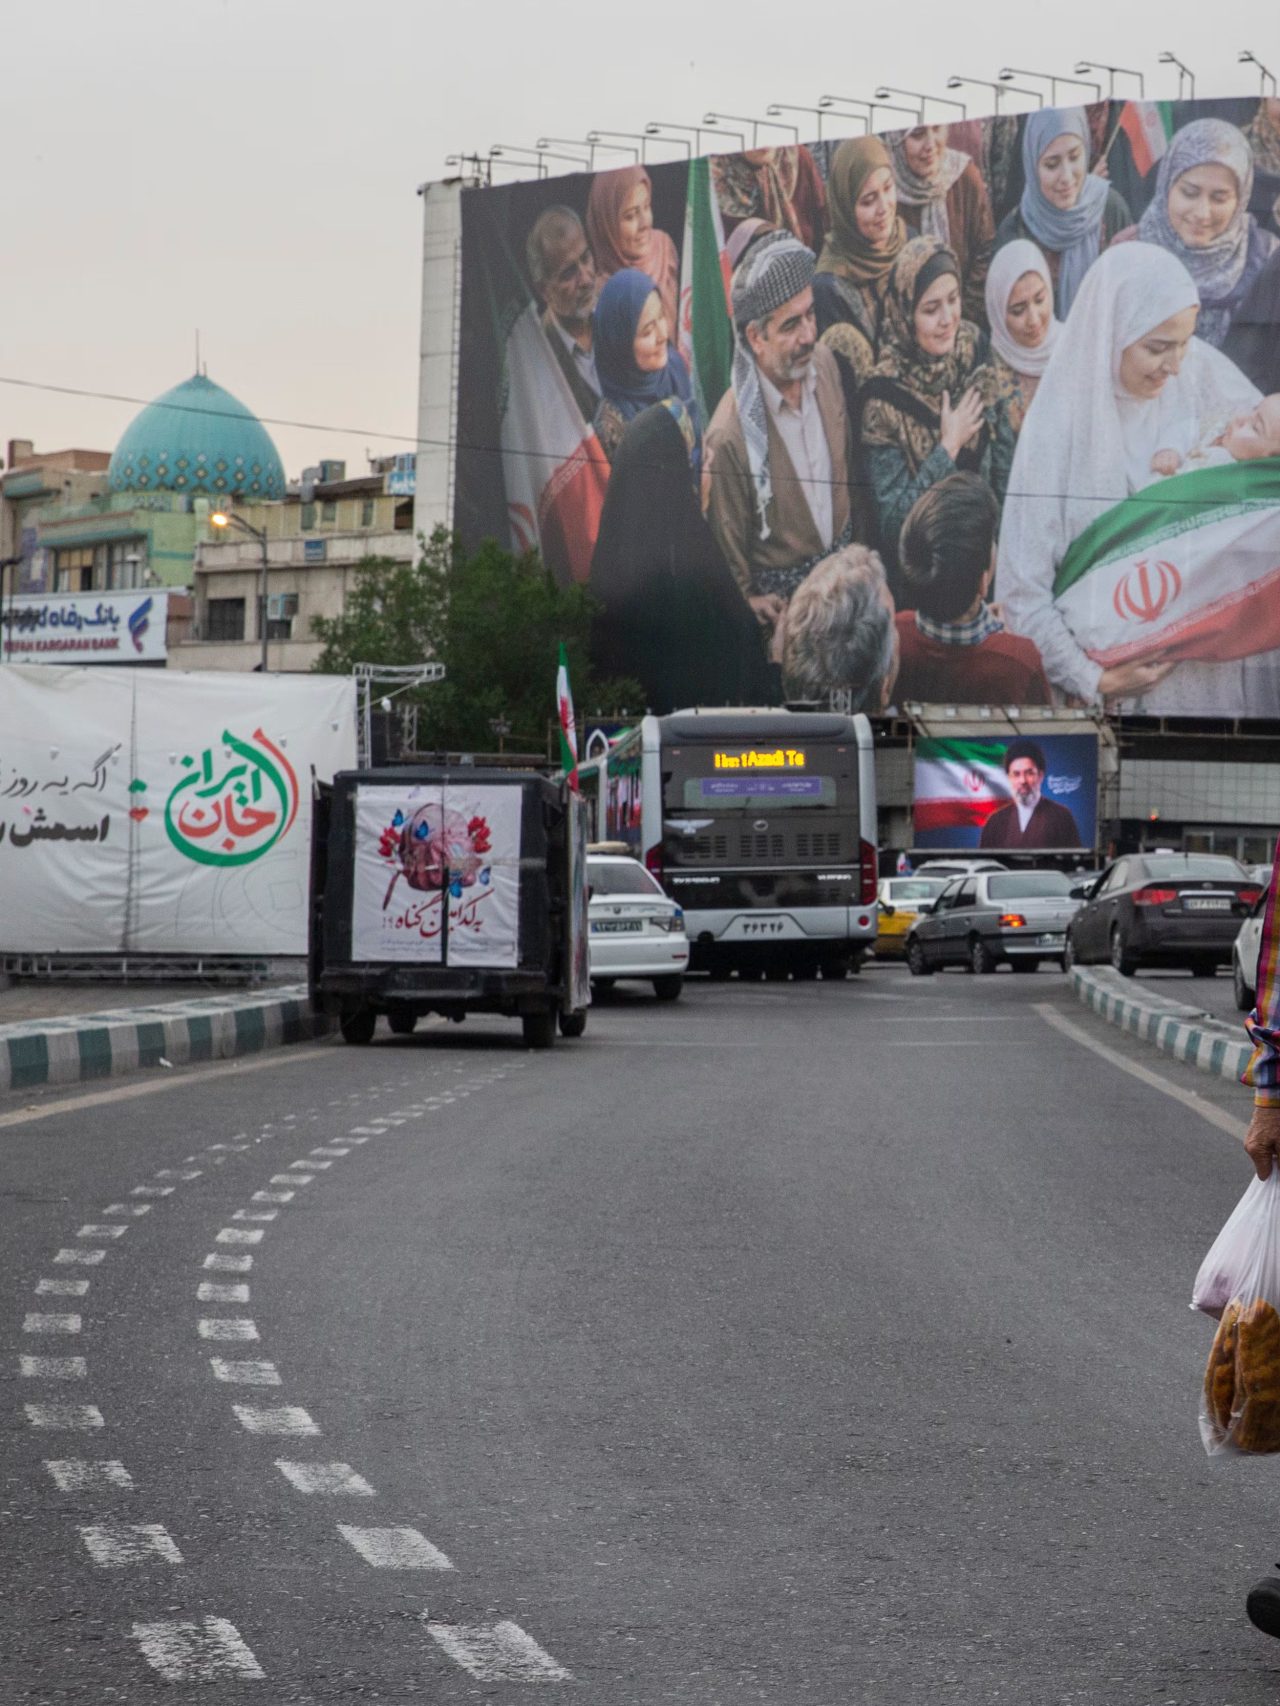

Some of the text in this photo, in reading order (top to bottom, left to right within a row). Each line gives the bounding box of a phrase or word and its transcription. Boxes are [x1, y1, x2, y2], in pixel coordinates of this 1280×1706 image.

[49, 603, 83, 631] رفاه
[85, 602, 121, 632] بانک
[1, 767, 38, 798] روز
[41, 775, 69, 796] یه
[9, 807, 110, 847] اسمش
[178, 794, 277, 851] جان
